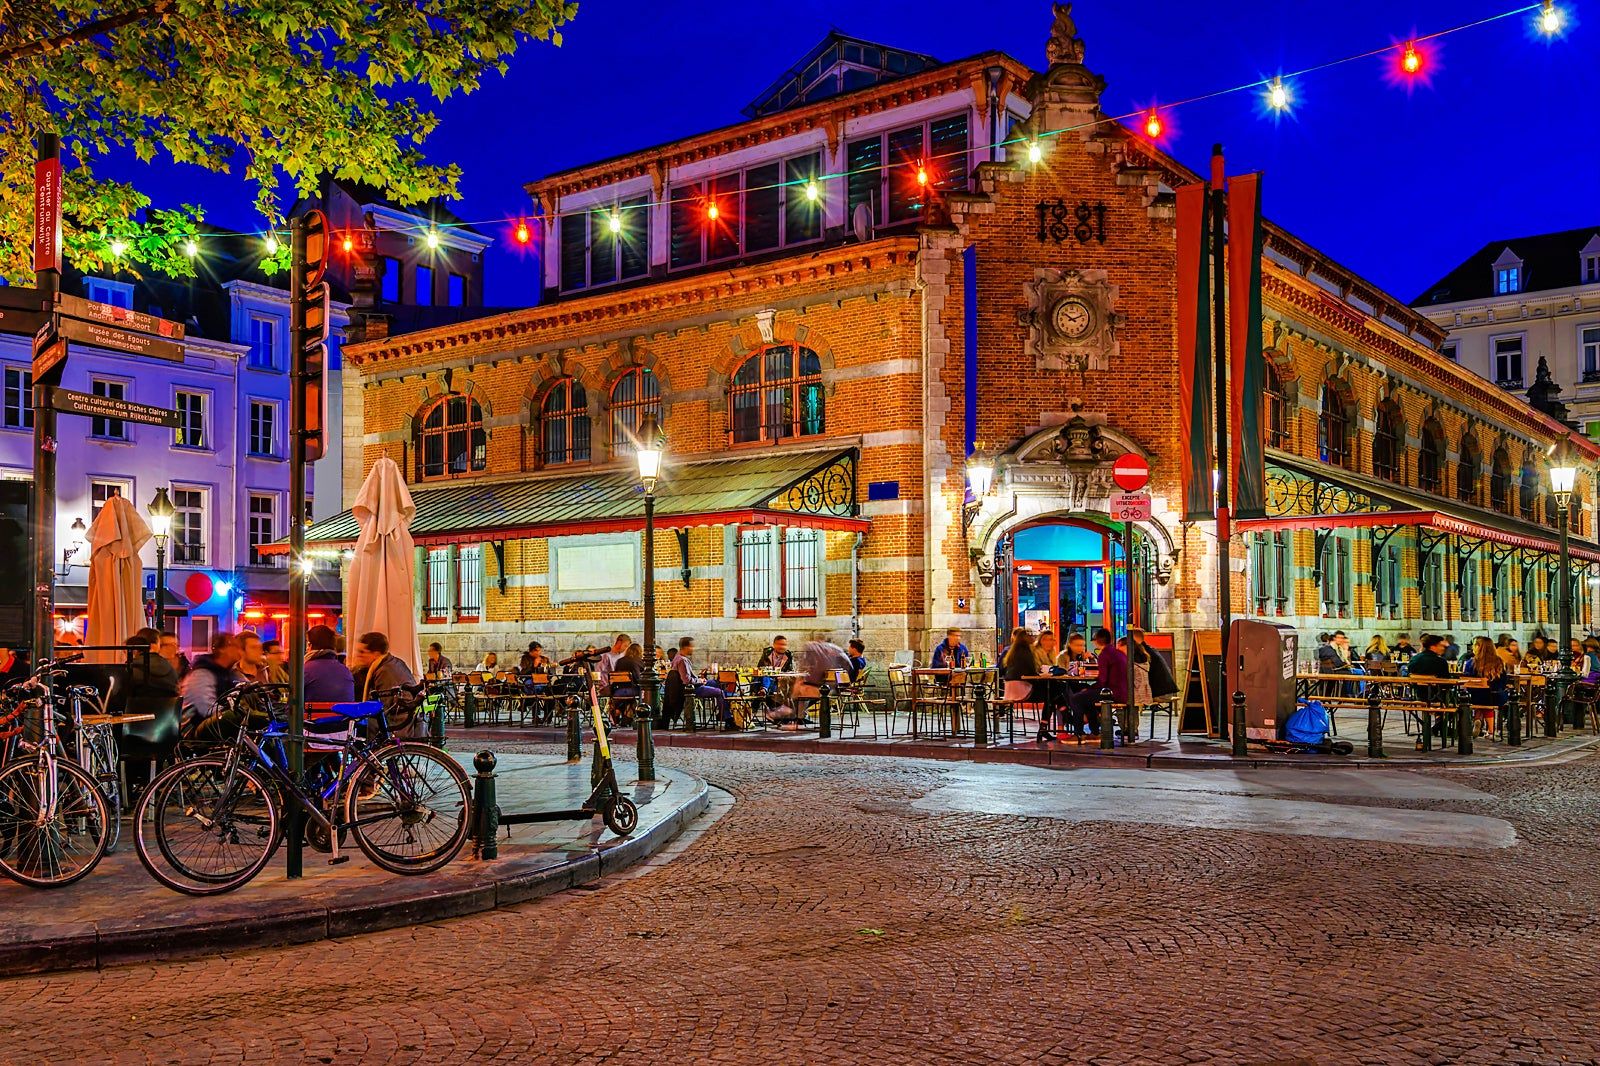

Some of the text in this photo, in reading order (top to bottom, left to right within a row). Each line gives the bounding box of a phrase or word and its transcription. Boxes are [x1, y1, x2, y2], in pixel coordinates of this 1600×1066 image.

[46, 211, 50, 222] du
[1035, 198, 1107, 244] 1881
[95, 335, 144, 352] Riolenmuseum
[112, 331, 125, 340] des
[127, 334, 151, 346] Egouts
[67, 393, 168, 417] Centre culturel des Riches Claires
[73, 402, 162, 424] Cultureelcentrum Rijkeklaren
